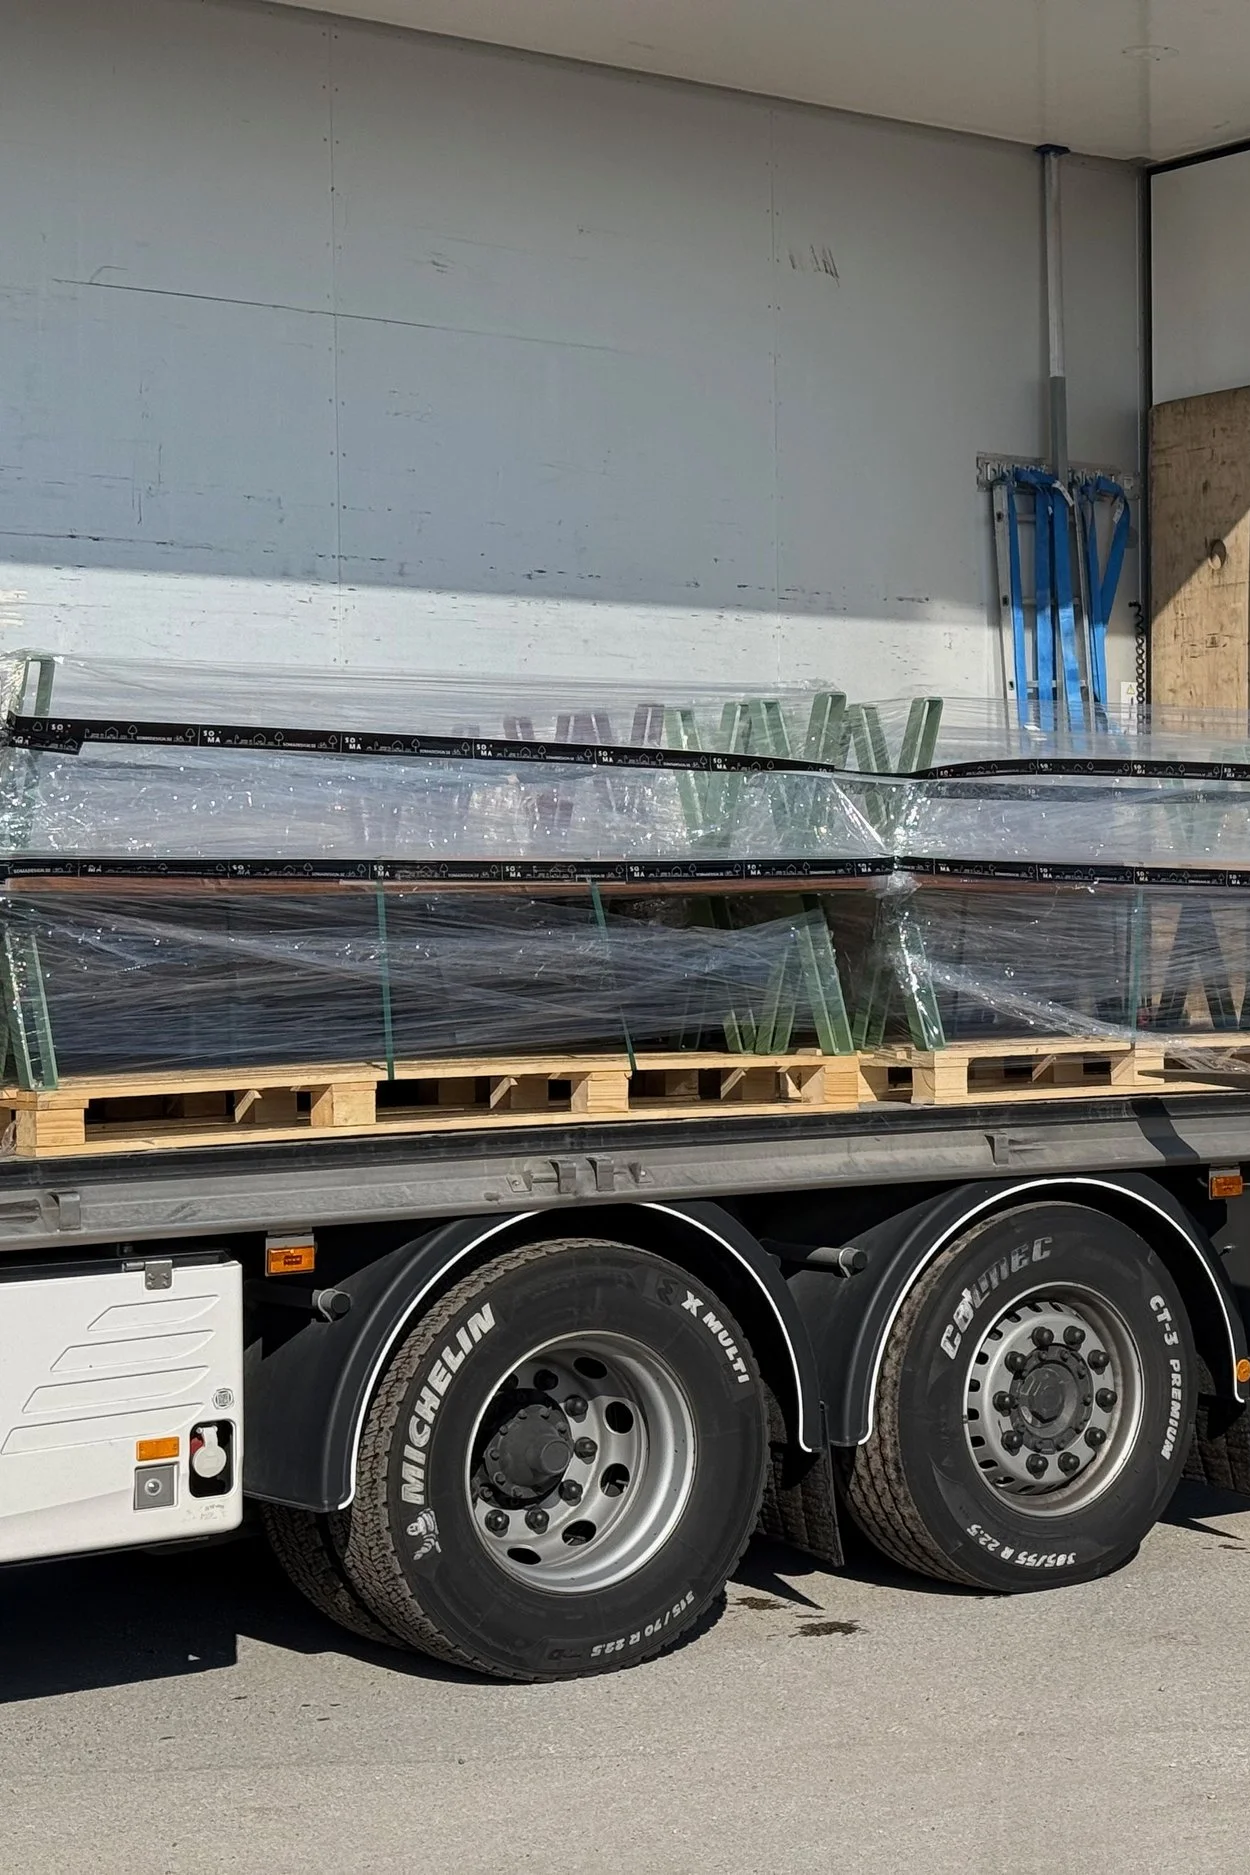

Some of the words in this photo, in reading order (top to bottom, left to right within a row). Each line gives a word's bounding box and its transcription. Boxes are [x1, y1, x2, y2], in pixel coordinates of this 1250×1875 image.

[681, 1290, 704, 1318] X
[702, 1311, 750, 1383] MULTI
[1150, 1294, 1179, 1346] CT-3
[401, 1301, 496, 1505] MICHELIN
[1160, 1359, 1182, 1460] PREMIUM
[966, 1524, 1001, 1551] 22.5
[1000, 1546, 1015, 1560] R
[1014, 1552, 1076, 1568] 385/55
[644, 1590, 695, 1637] 315/70
[590, 1638, 625, 1658] 22.5
[629, 1631, 641, 1645] R
